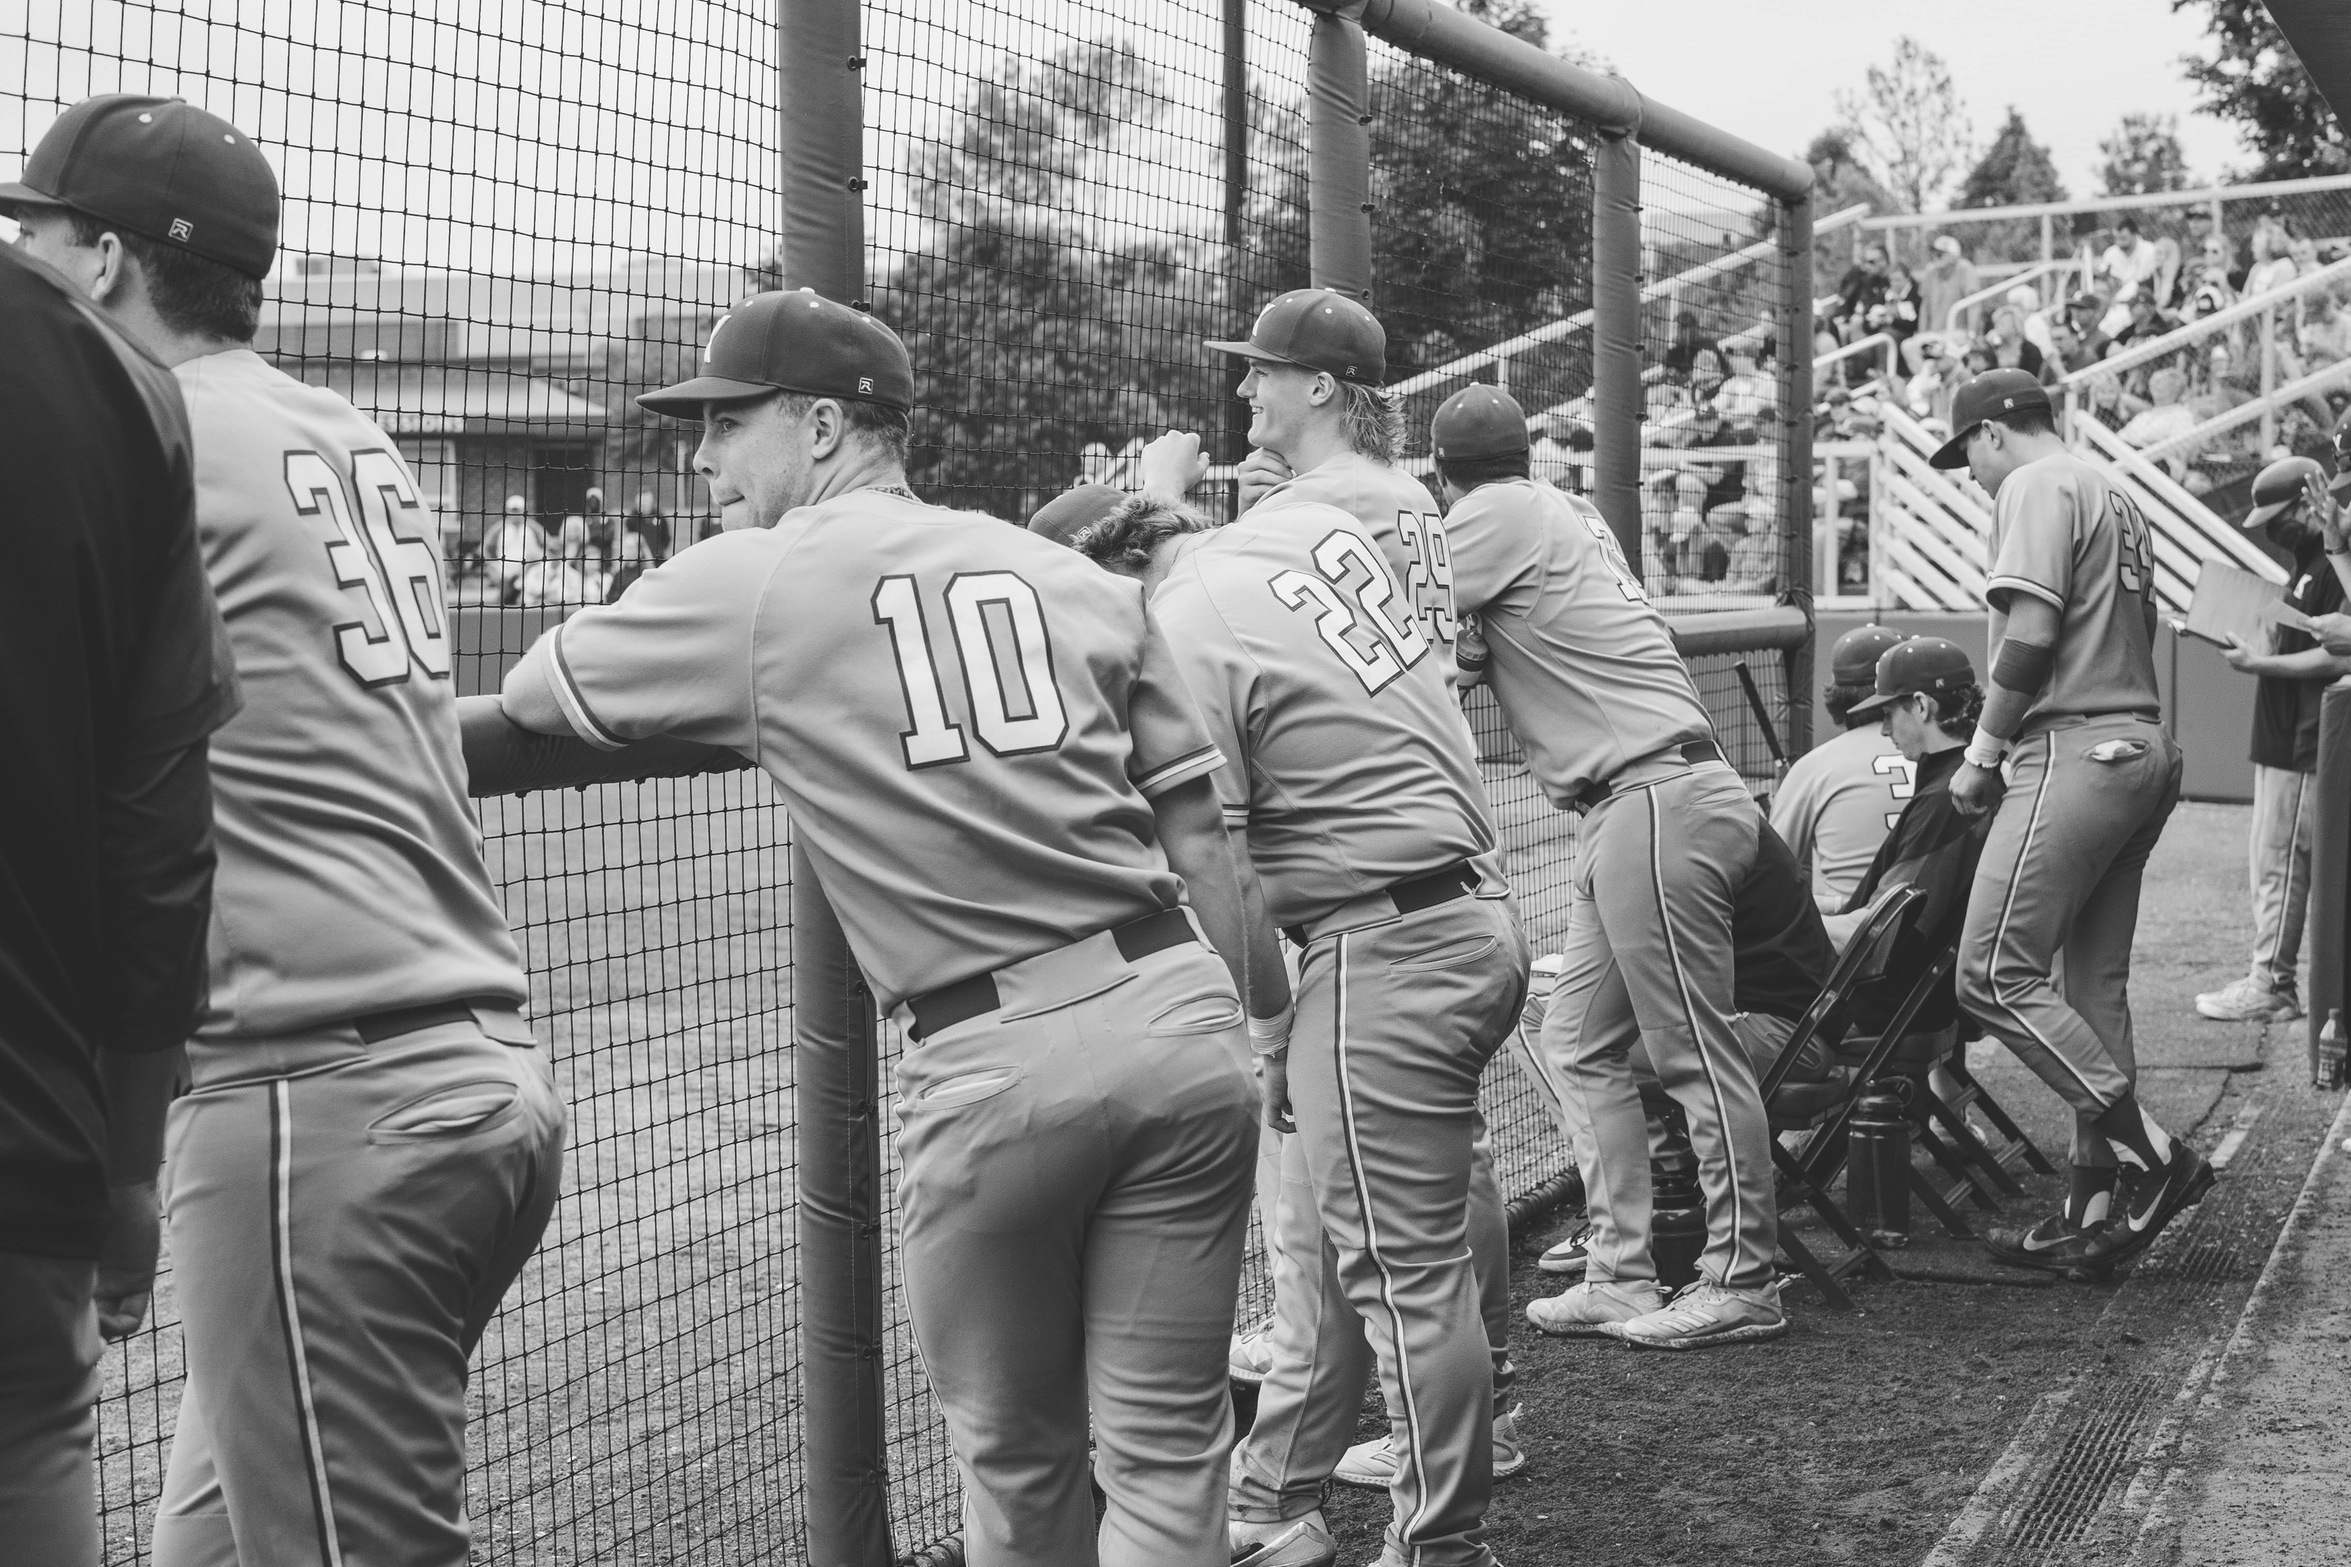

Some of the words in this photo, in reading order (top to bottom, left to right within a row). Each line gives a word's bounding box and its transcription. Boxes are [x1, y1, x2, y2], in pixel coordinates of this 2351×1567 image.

[283, 447, 450, 690] 36
[1267, 528, 1430, 698] 22
[1397, 509, 1456, 645] 29
[870, 570, 1070, 771] 10
